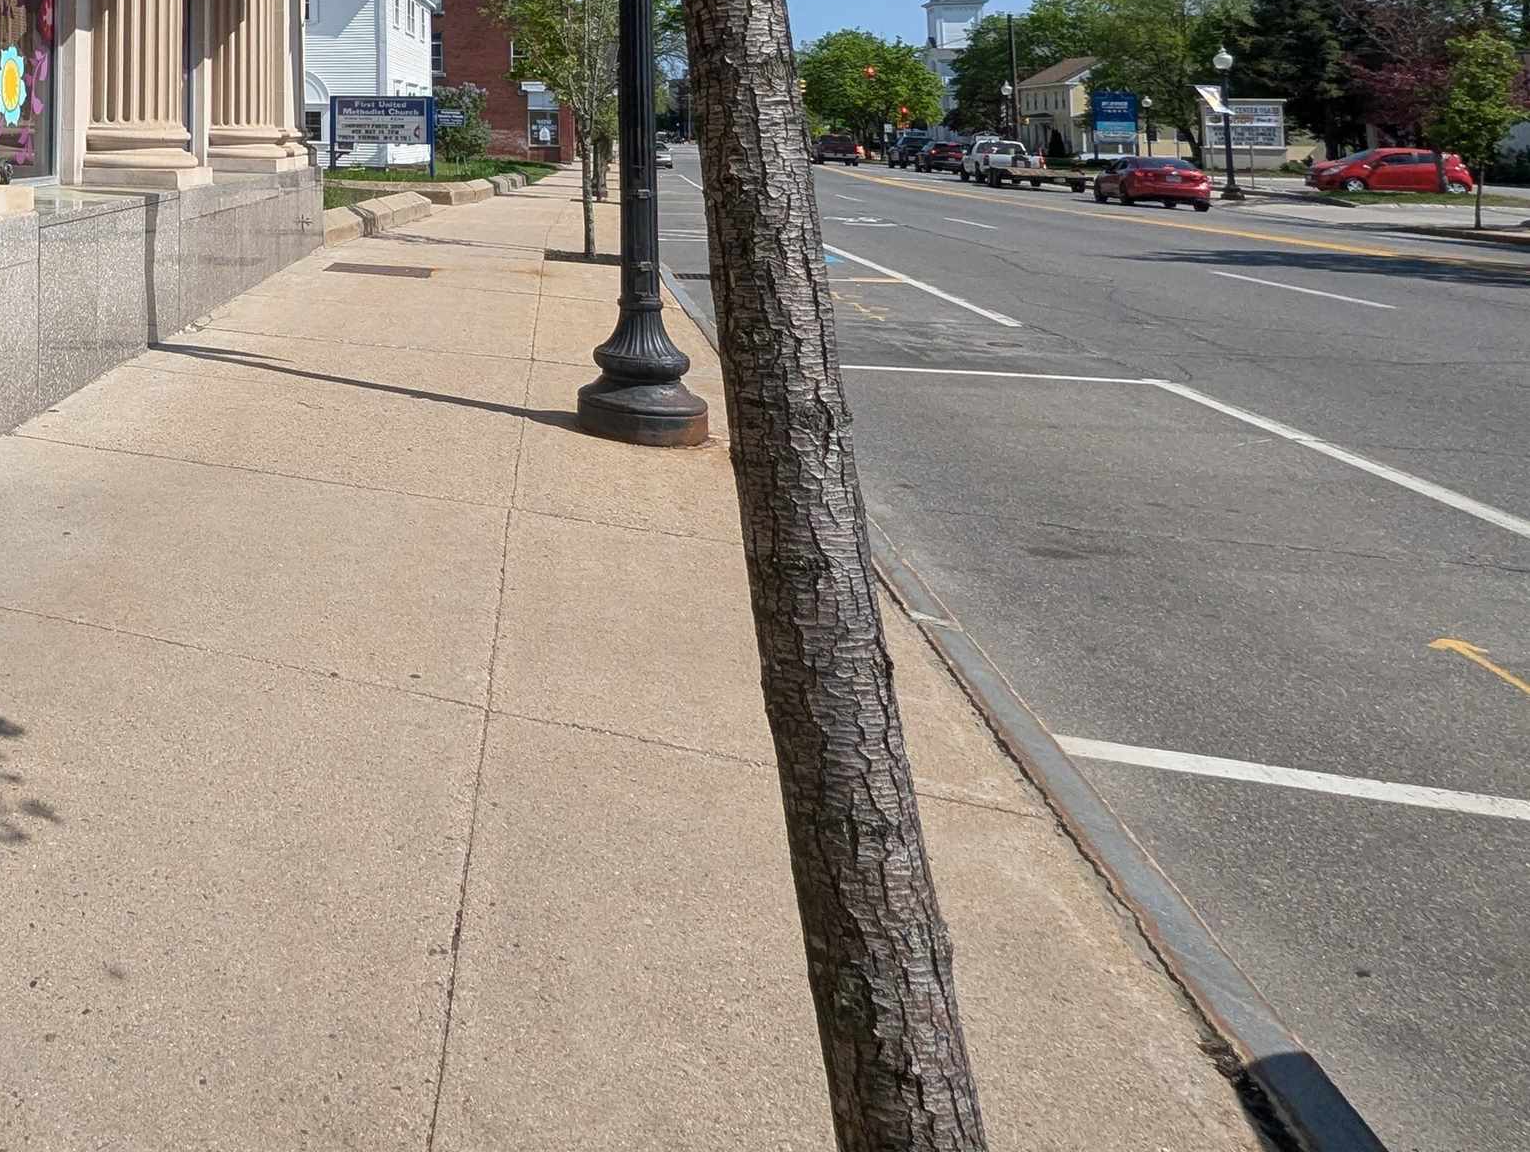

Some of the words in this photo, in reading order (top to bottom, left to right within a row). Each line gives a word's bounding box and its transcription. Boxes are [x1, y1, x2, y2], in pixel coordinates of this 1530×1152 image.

[354, 100, 375, 108] First
[378, 100, 407, 108] United
[342, 108, 385, 116] Methodist
[388, 108, 420, 116] Church
